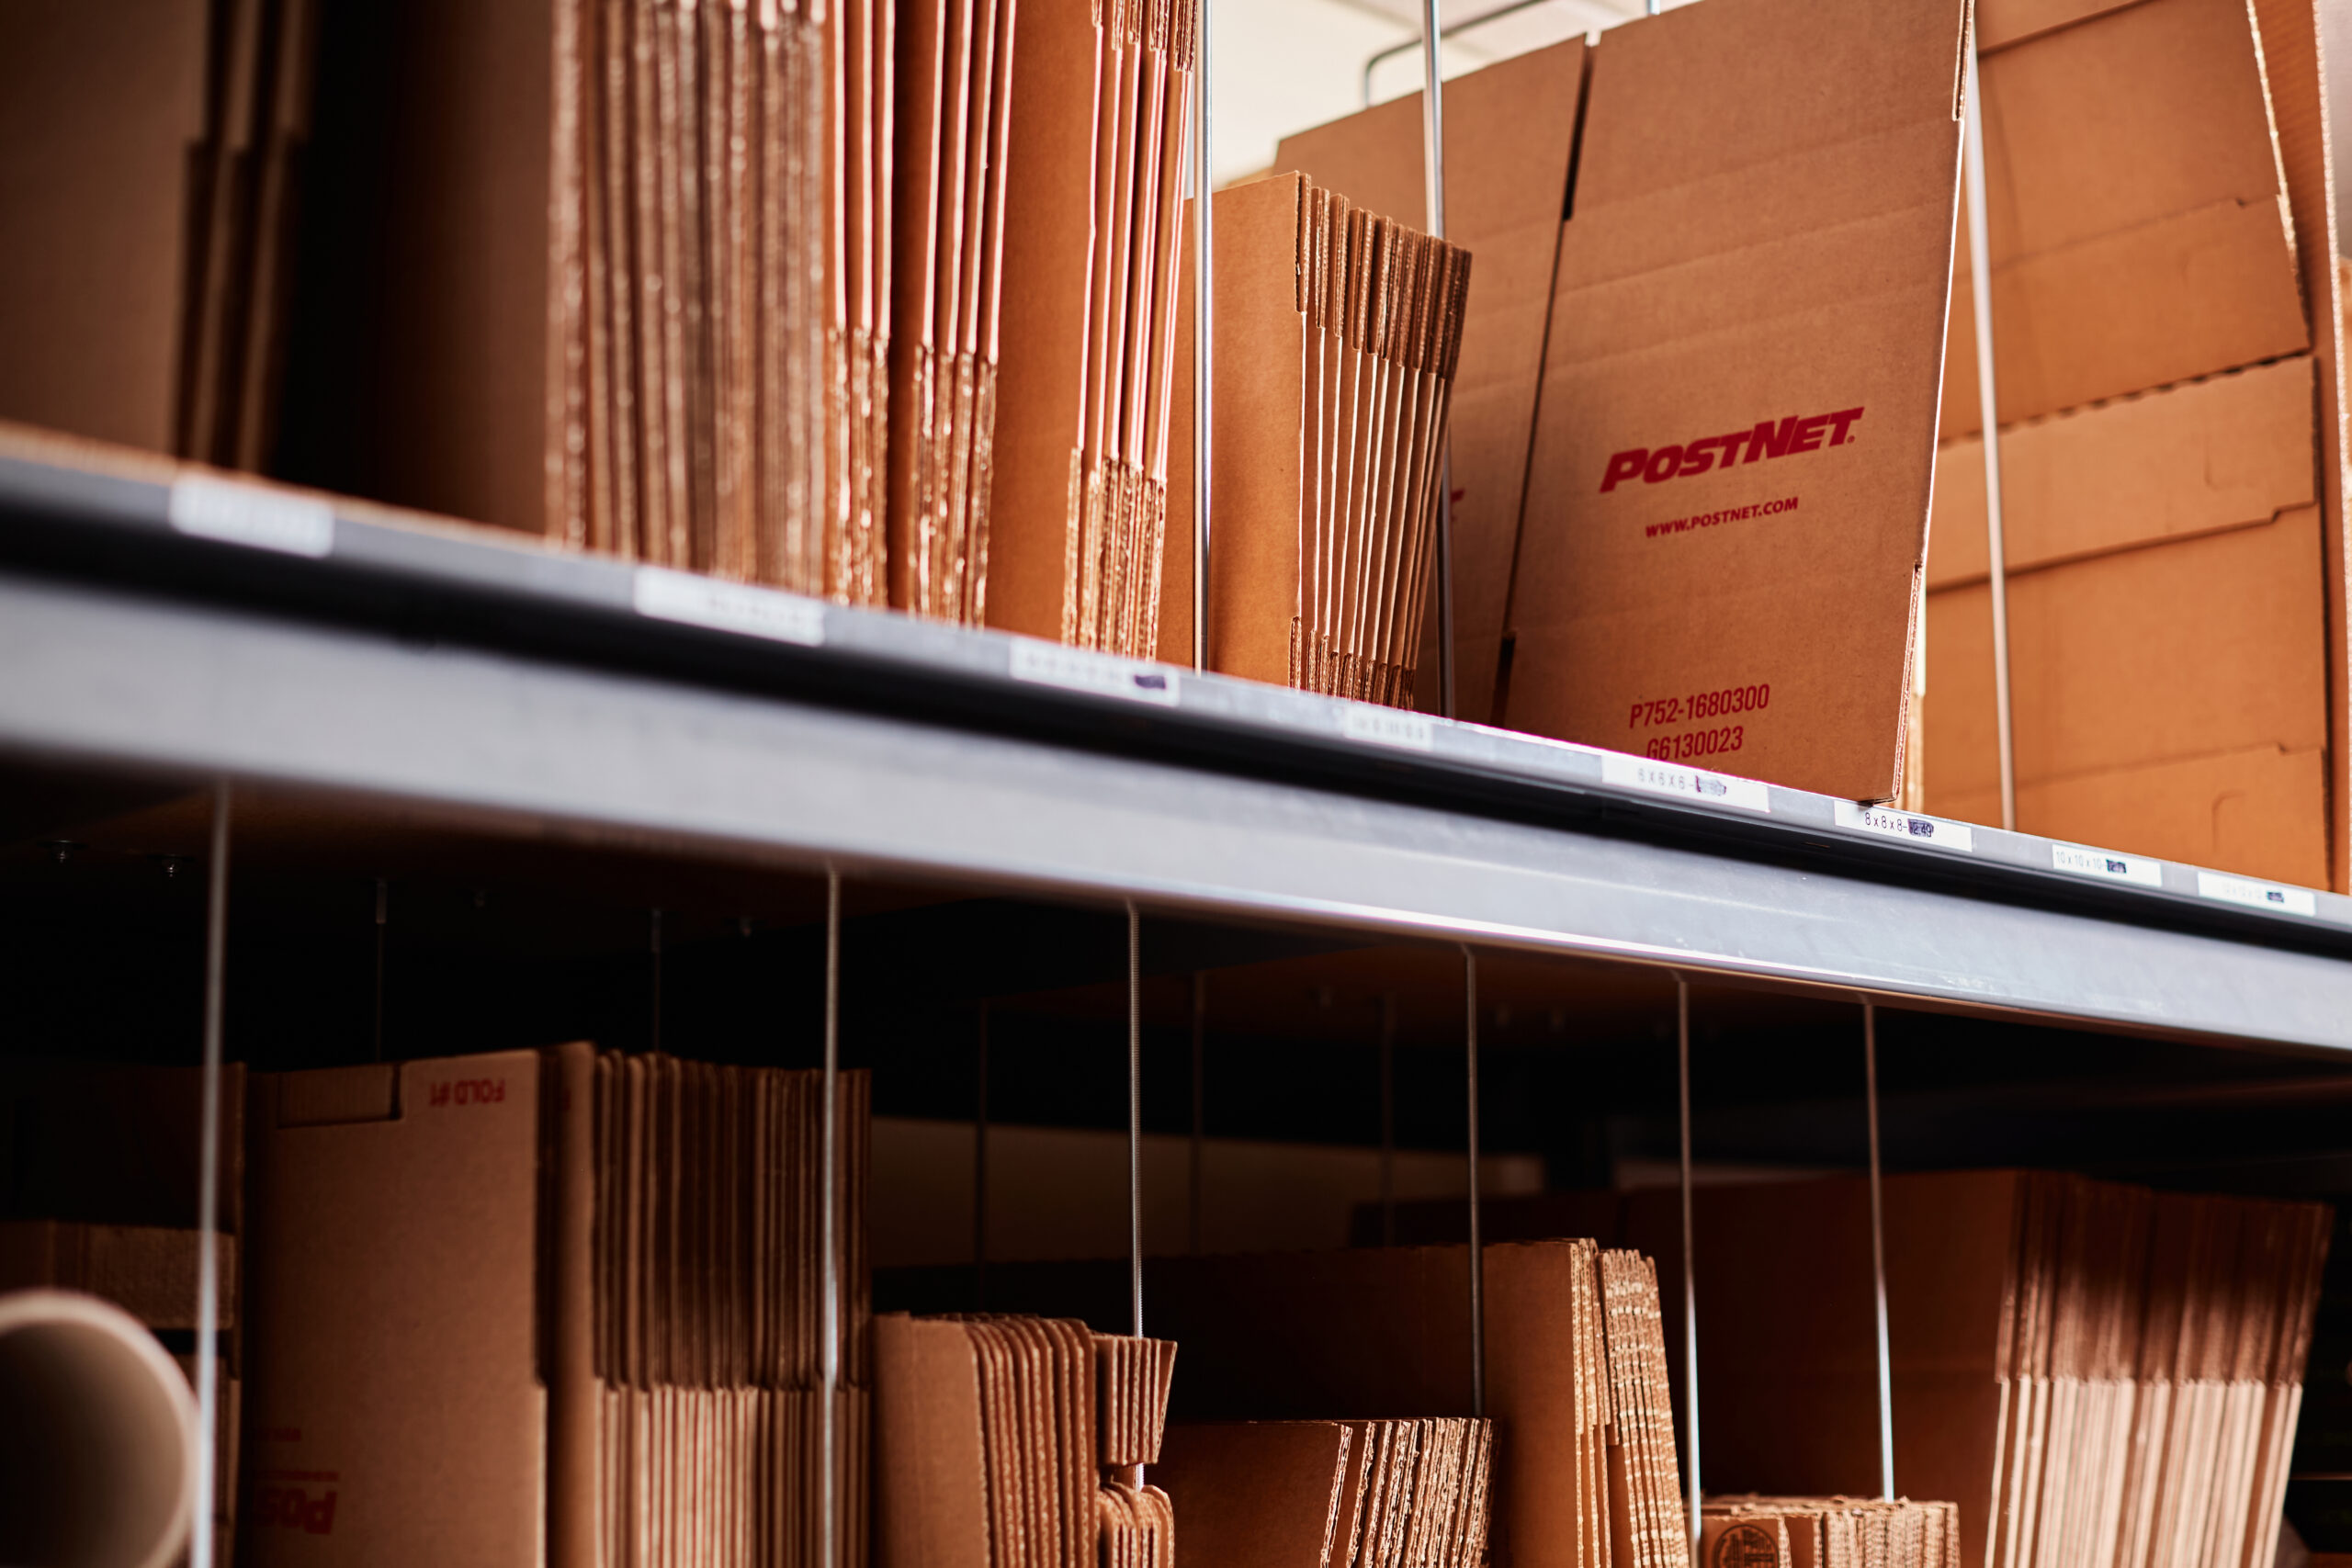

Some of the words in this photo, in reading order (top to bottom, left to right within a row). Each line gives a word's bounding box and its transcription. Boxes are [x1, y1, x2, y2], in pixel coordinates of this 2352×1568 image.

[1599, 406, 1865, 493] POSTNET
[1645, 497, 1799, 538] WWW.POSTNET.COM
[1629, 683, 1770, 729] P752-1680300
[1645, 726, 1744, 762] G6130023
[454, 1079, 507, 1106] FOLD
